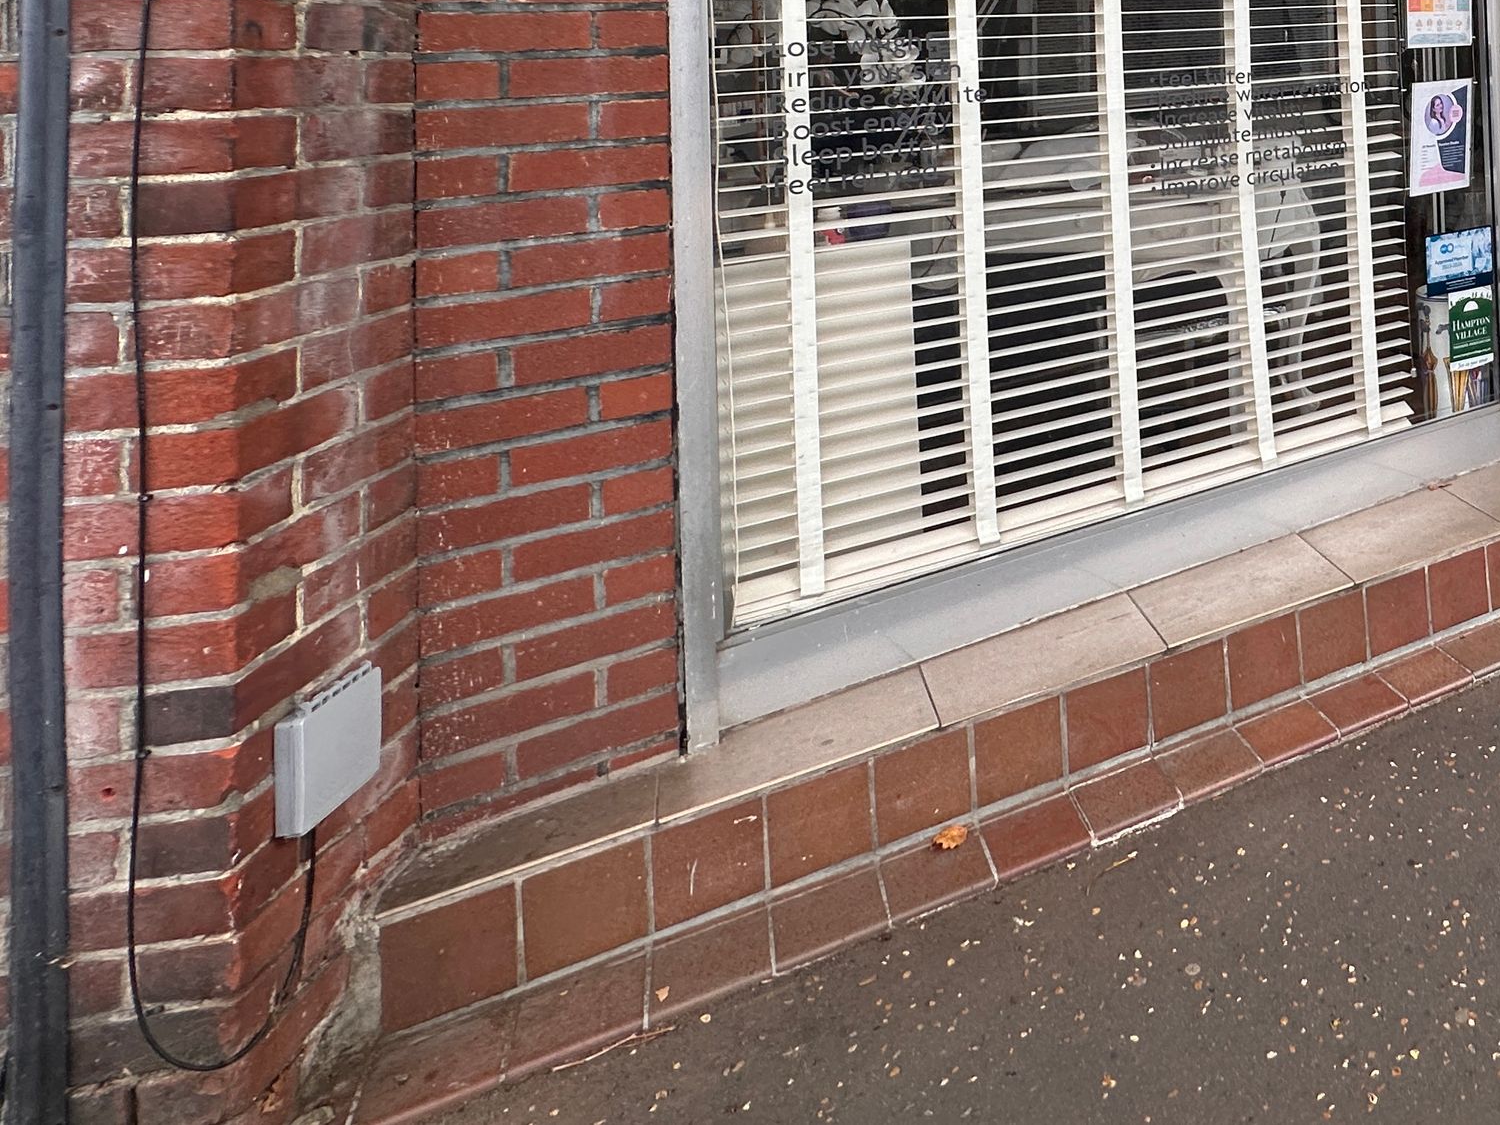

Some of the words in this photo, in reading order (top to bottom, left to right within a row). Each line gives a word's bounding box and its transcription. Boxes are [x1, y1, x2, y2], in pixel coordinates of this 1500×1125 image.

[772, 92, 876, 115] Reduce
[773, 118, 855, 142] Boost
[773, 142, 853, 171] Sleep
[1161, 152, 1239, 172] Increase
[1161, 175, 1240, 198] Improve
[1247, 160, 1340, 186] circulation
[1452, 315, 1491, 332] HAMPTON
[1455, 326, 1488, 340] VILLAGE
